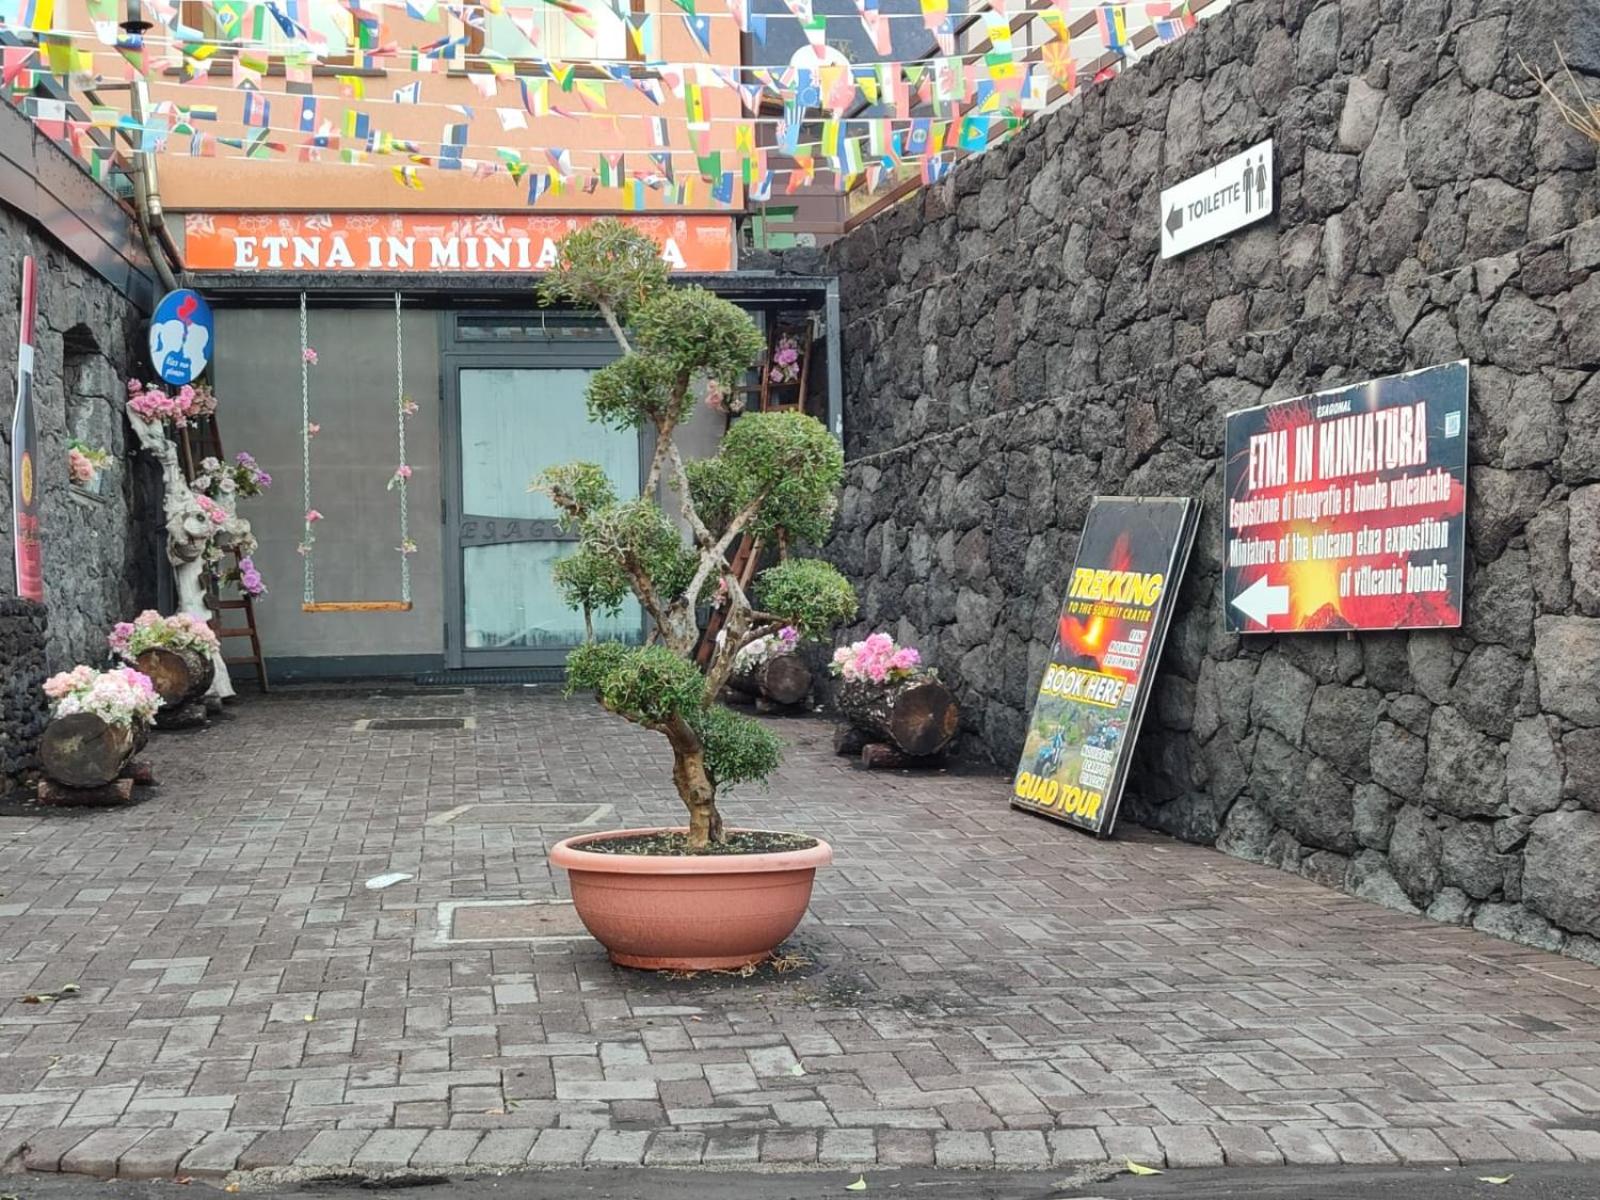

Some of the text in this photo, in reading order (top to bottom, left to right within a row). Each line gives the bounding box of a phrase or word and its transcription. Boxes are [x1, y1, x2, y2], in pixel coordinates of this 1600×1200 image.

[1188, 181, 1241, 222] TOILETTE
[234, 236, 688, 269] ETNA IN MINIAA
[1249, 402, 1427, 491] ETNA IN MINIATURA
[1229, 467, 1451, 529] Esposizione di fotografie e bombe vulcaniche
[1229, 518, 1449, 568] Miniature of the volcano etna exposition
[1068, 567, 1164, 607] TREKKING
[1339, 566, 1353, 598] of
[1406, 559, 1448, 594] bombs
[1067, 601, 1152, 623] TO THE SUMMIT CRATER
[1042, 666, 1083, 696] BOOK
[1086, 673, 1124, 705] HERE
[1016, 772, 1102, 819] QUAD TOUR
